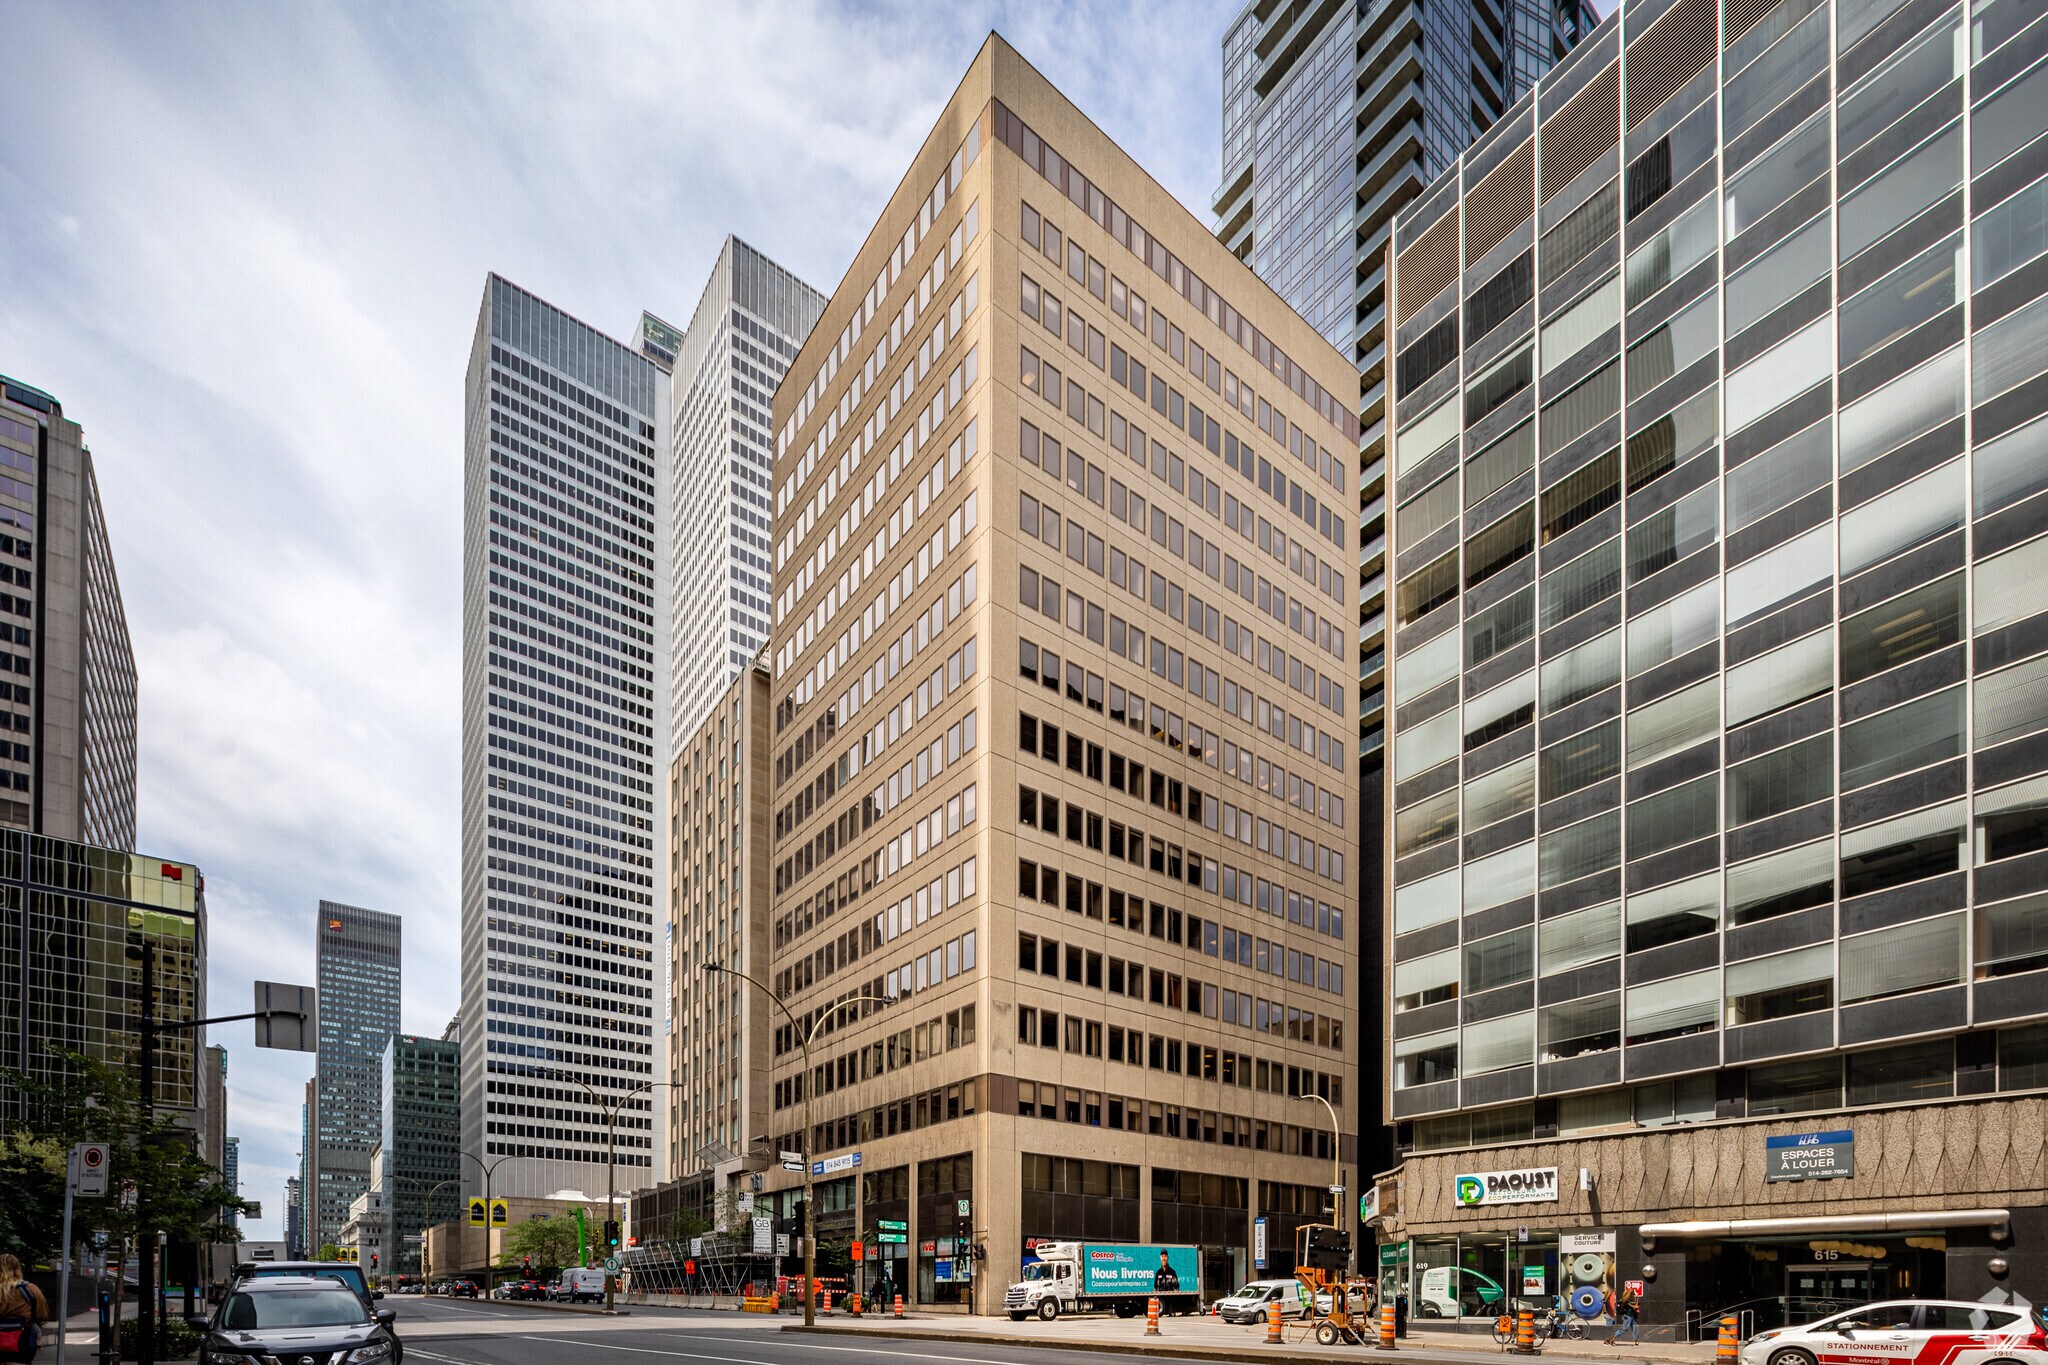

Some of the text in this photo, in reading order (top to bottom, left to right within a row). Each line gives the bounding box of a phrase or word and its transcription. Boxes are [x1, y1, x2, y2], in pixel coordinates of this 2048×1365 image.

[1781, 1148, 1834, 1160] ESPACES
[1781, 1158, 1835, 1170] À LOUER
[1488, 1171, 1555, 1190] DAOUST
[922, 1244, 935, 1252] IVD
[1814, 1250, 1839, 1260] 615
[1091, 1267, 1155, 1279] Nous livrons
[1827, 1342, 1909, 1352] STATIONNEMENT
[1848, 1356, 1880, 1364] Montréal
